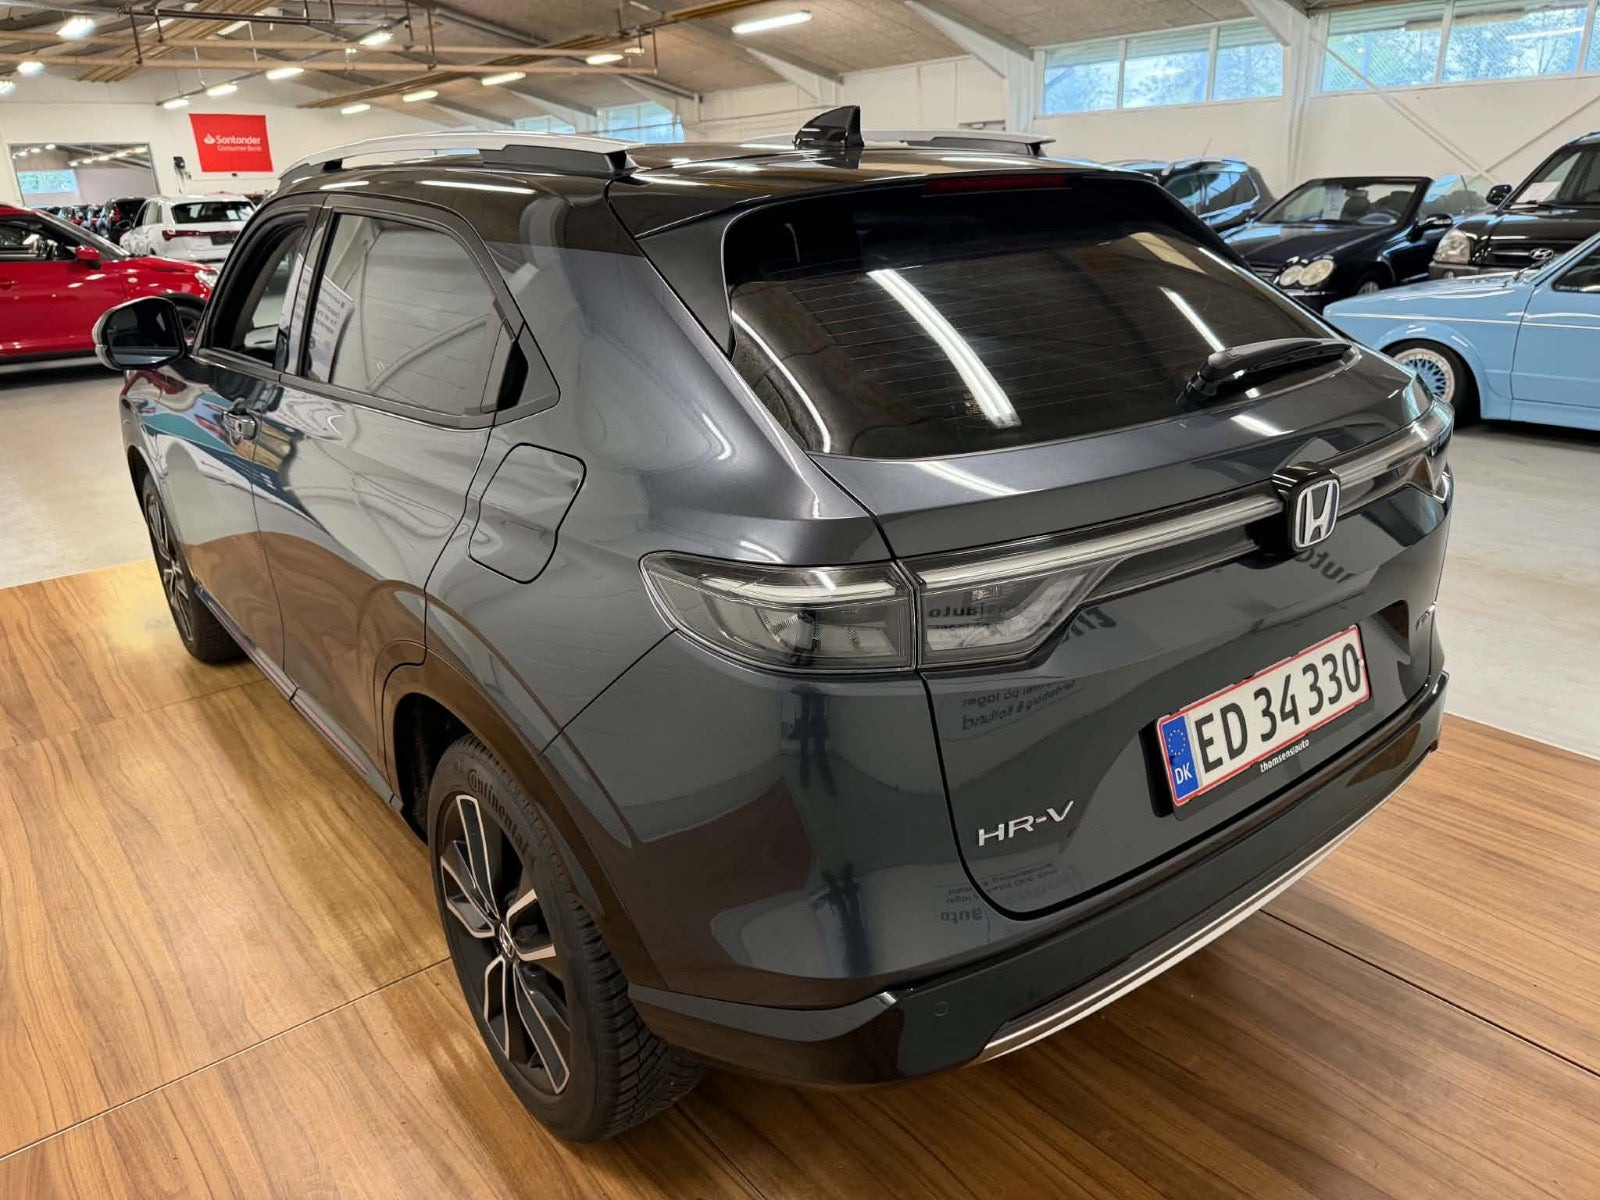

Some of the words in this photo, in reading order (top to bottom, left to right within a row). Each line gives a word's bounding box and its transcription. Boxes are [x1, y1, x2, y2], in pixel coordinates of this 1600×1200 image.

[215, 134, 261, 144] Santander
[1194, 702, 1248, 774] ED
[1253, 674, 1300, 743] 34
[1302, 643, 1361, 716] 330
[1174, 762, 1193, 785] DK
[467, 769, 529, 855] Continental
[978, 800, 1074, 847] HR-V
